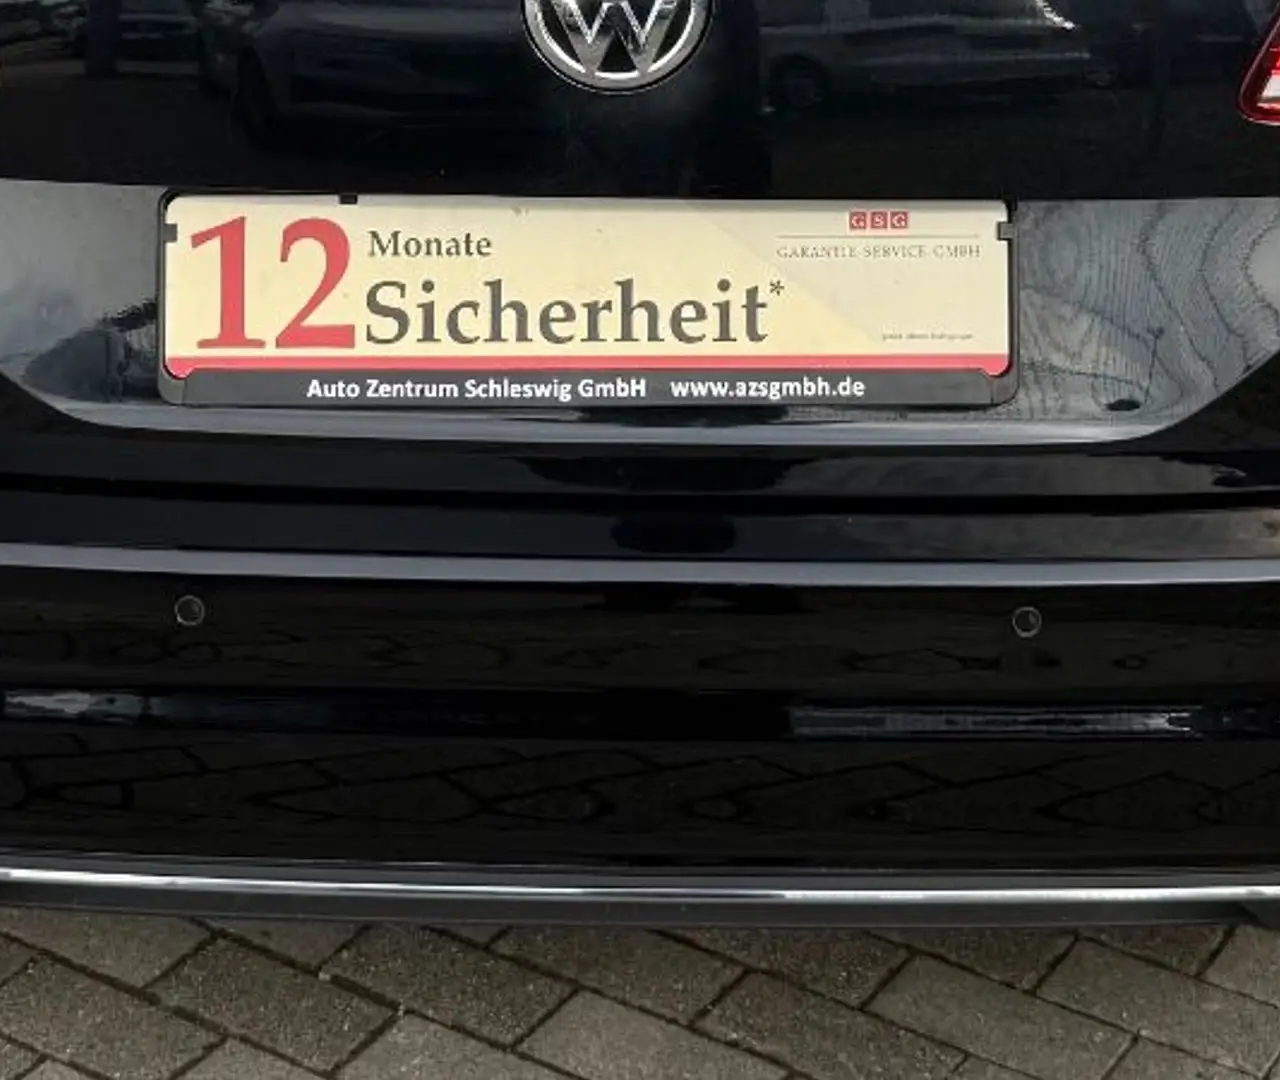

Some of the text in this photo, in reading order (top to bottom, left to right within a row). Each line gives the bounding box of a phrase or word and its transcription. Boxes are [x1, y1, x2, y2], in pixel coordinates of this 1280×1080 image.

[849, 211, 909, 229] GSG
[368, 230, 492, 257] Monate
[190, 216, 356, 349] 12
[306, 375, 866, 402] Auto Zentrum Schleswig GmbH www.azsgmbh.de
